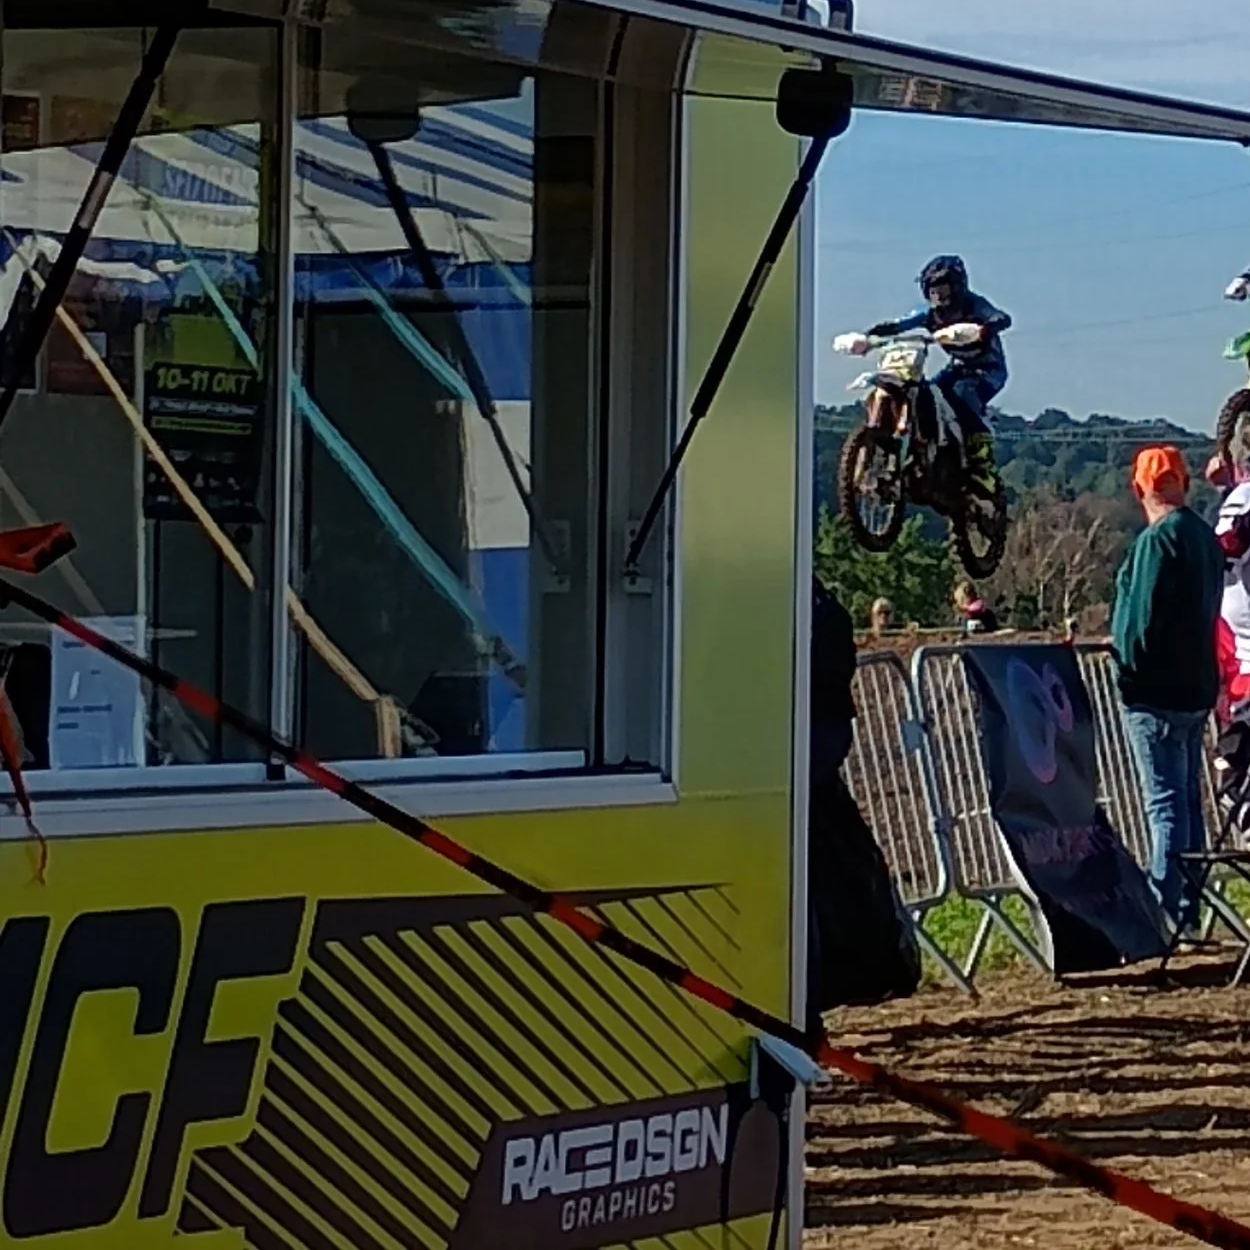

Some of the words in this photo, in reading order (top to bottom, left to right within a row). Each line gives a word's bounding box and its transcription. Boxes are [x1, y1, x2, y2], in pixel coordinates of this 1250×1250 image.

[156, 366, 210, 393] 10-11
[211, 372, 253, 396] OKT
[560, 1180, 677, 1232] GRAPHICS
